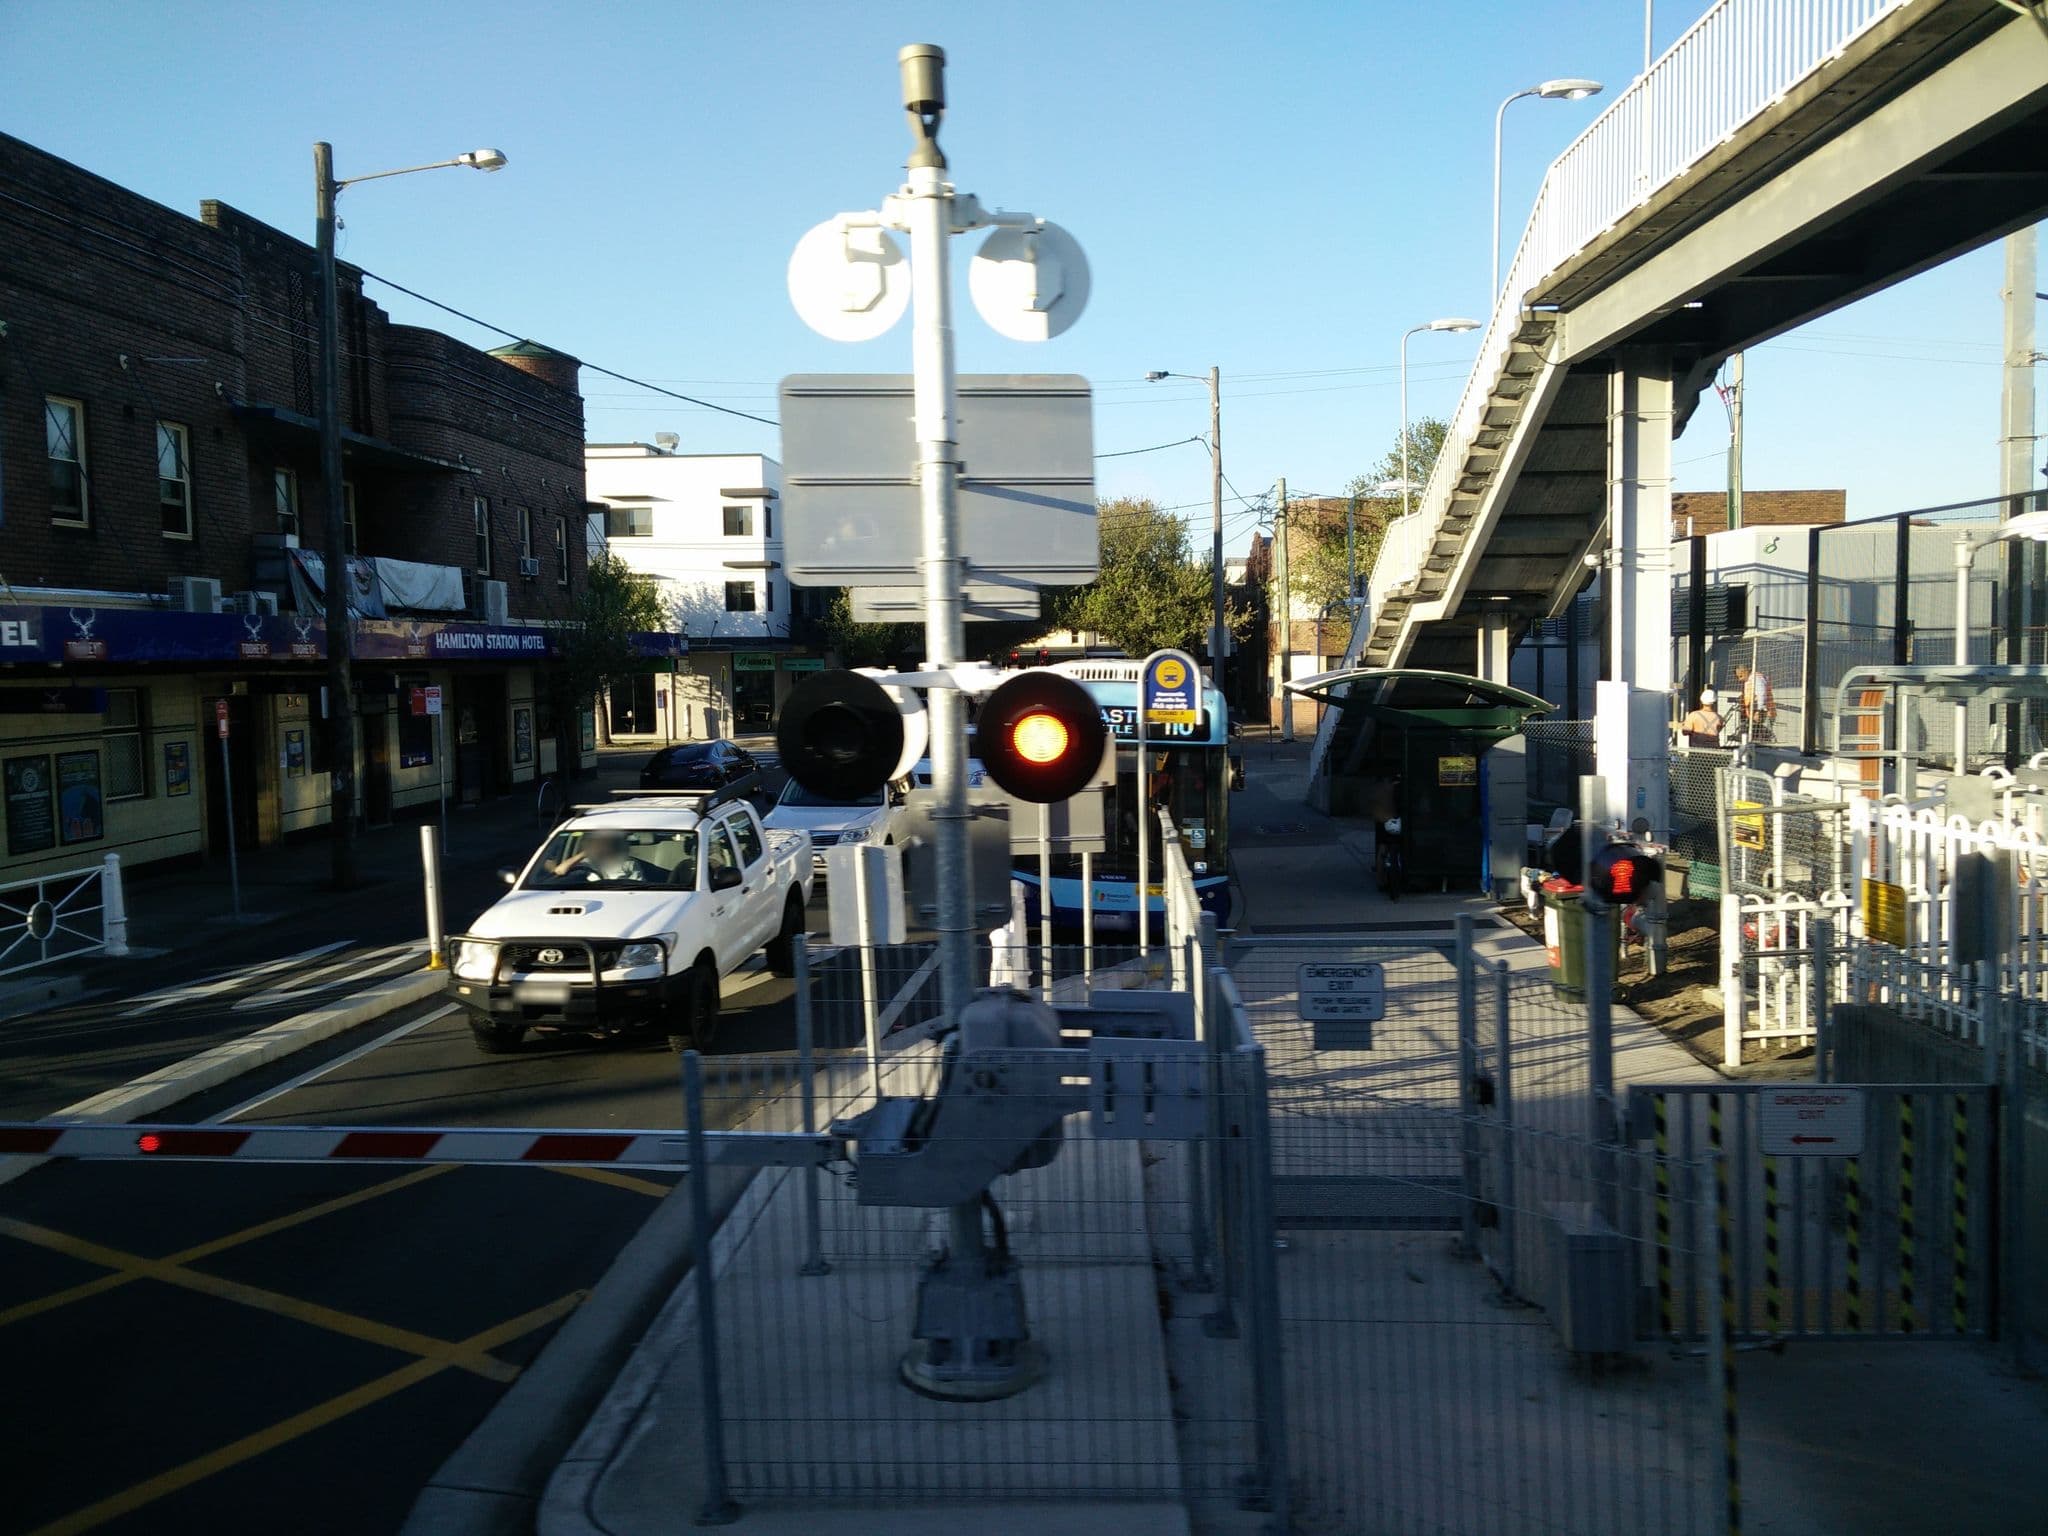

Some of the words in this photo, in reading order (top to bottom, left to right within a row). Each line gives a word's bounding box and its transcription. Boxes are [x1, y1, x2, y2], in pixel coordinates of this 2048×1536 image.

[436, 631, 485, 650] HAMILTON
[486, 633, 520, 650] STATION
[522, 634, 545, 650] HOTEL
[1306, 967, 1375, 978] EMERGENCY
[1328, 980, 1354, 991] EXIT
